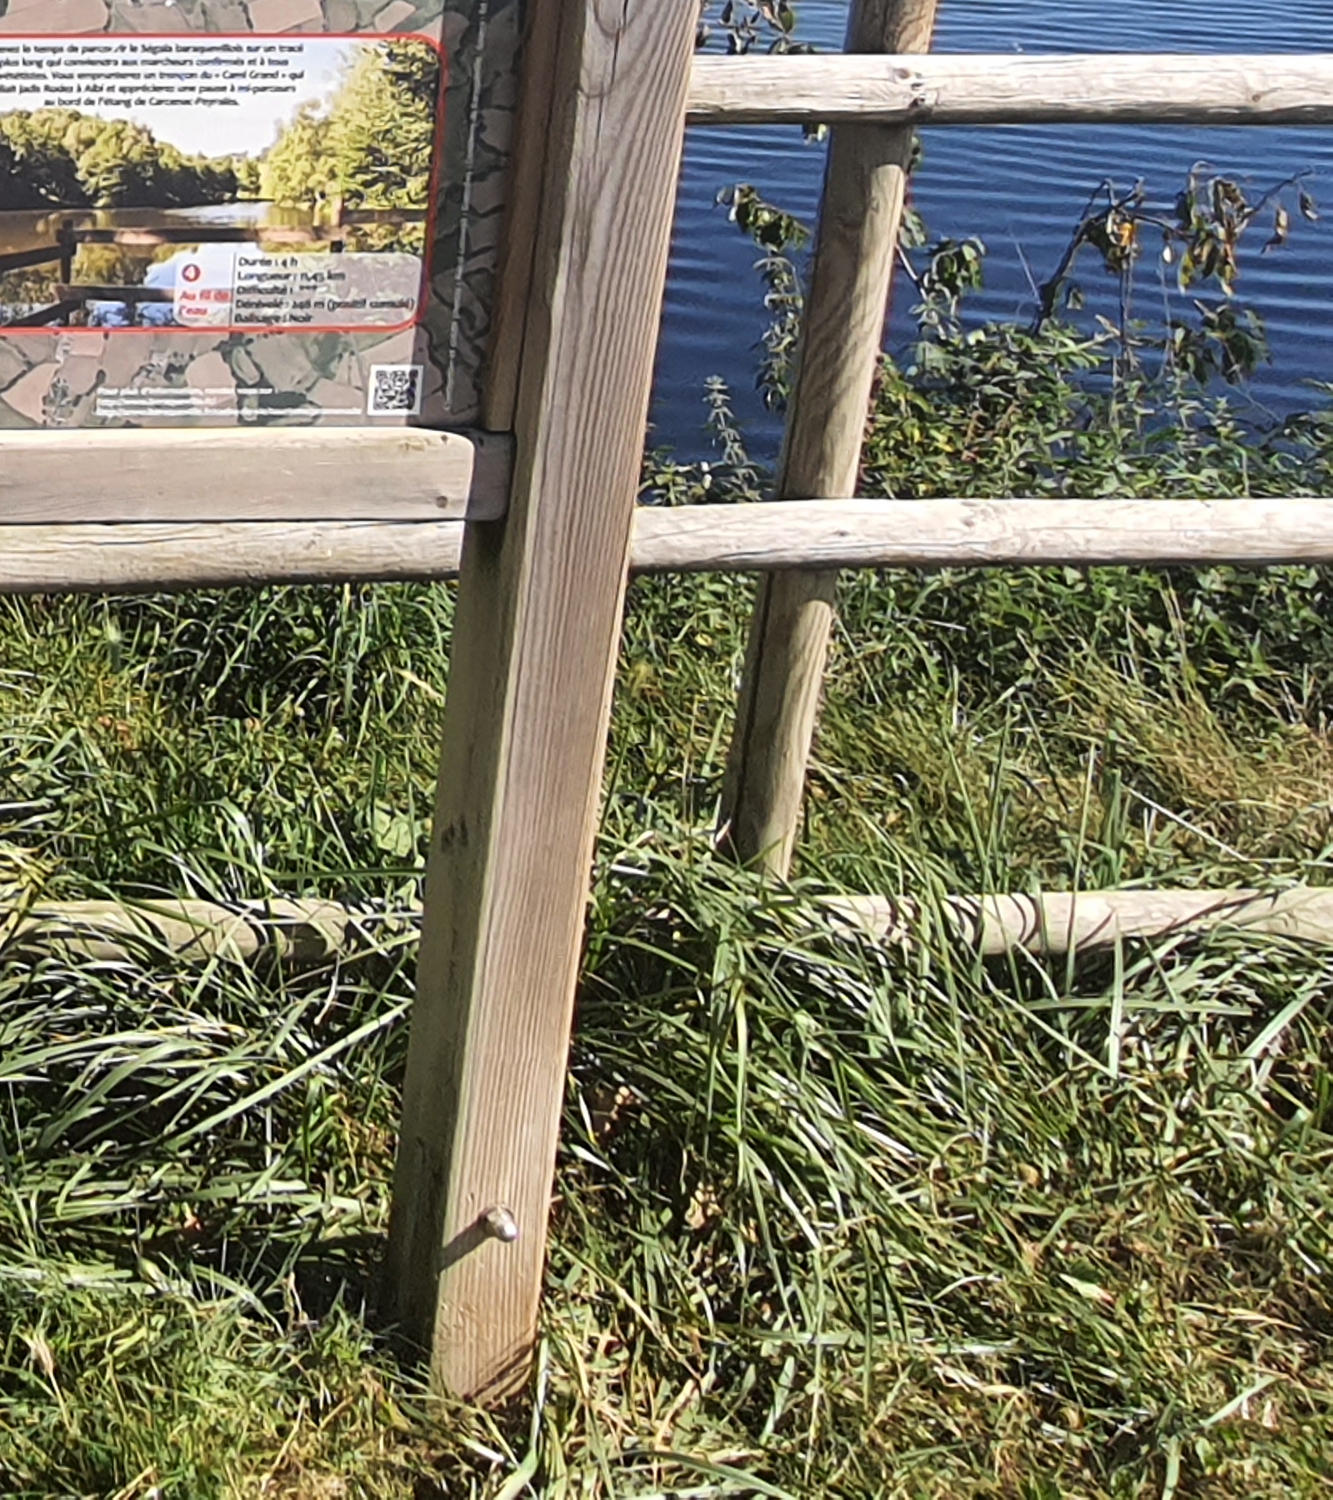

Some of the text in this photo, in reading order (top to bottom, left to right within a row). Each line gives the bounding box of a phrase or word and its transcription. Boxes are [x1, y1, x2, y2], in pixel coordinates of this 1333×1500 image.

[239, 257, 272, 267] Durée
[237, 271, 291, 282] Longueur
[327, 270, 345, 280] km
[289, 314, 312, 323] Noir
